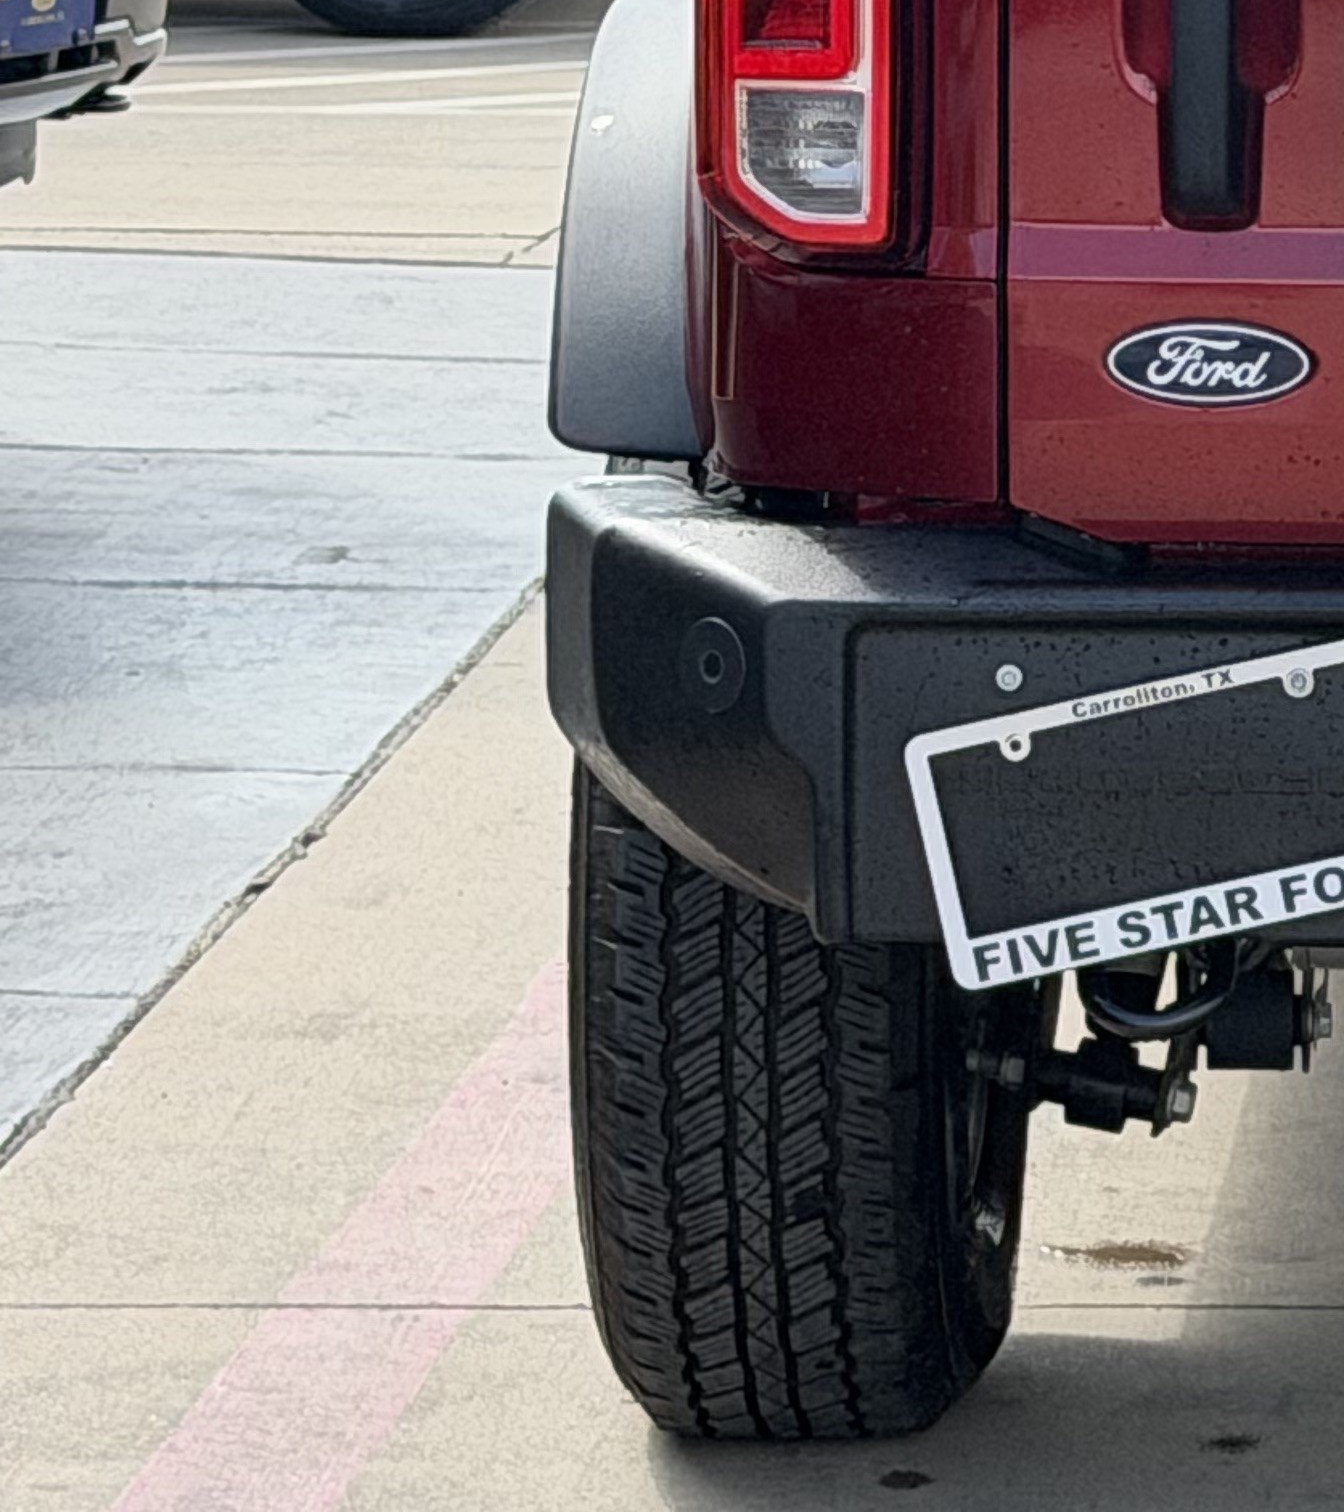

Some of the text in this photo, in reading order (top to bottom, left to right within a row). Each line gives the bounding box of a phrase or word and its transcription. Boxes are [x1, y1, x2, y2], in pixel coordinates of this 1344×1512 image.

[1146, 336, 1271, 388] Ford
[1071, 668, 1235, 718] Carrollton, TX
[971, 920, 1101, 983] FIVE
[1116, 885, 1264, 949] STAR
